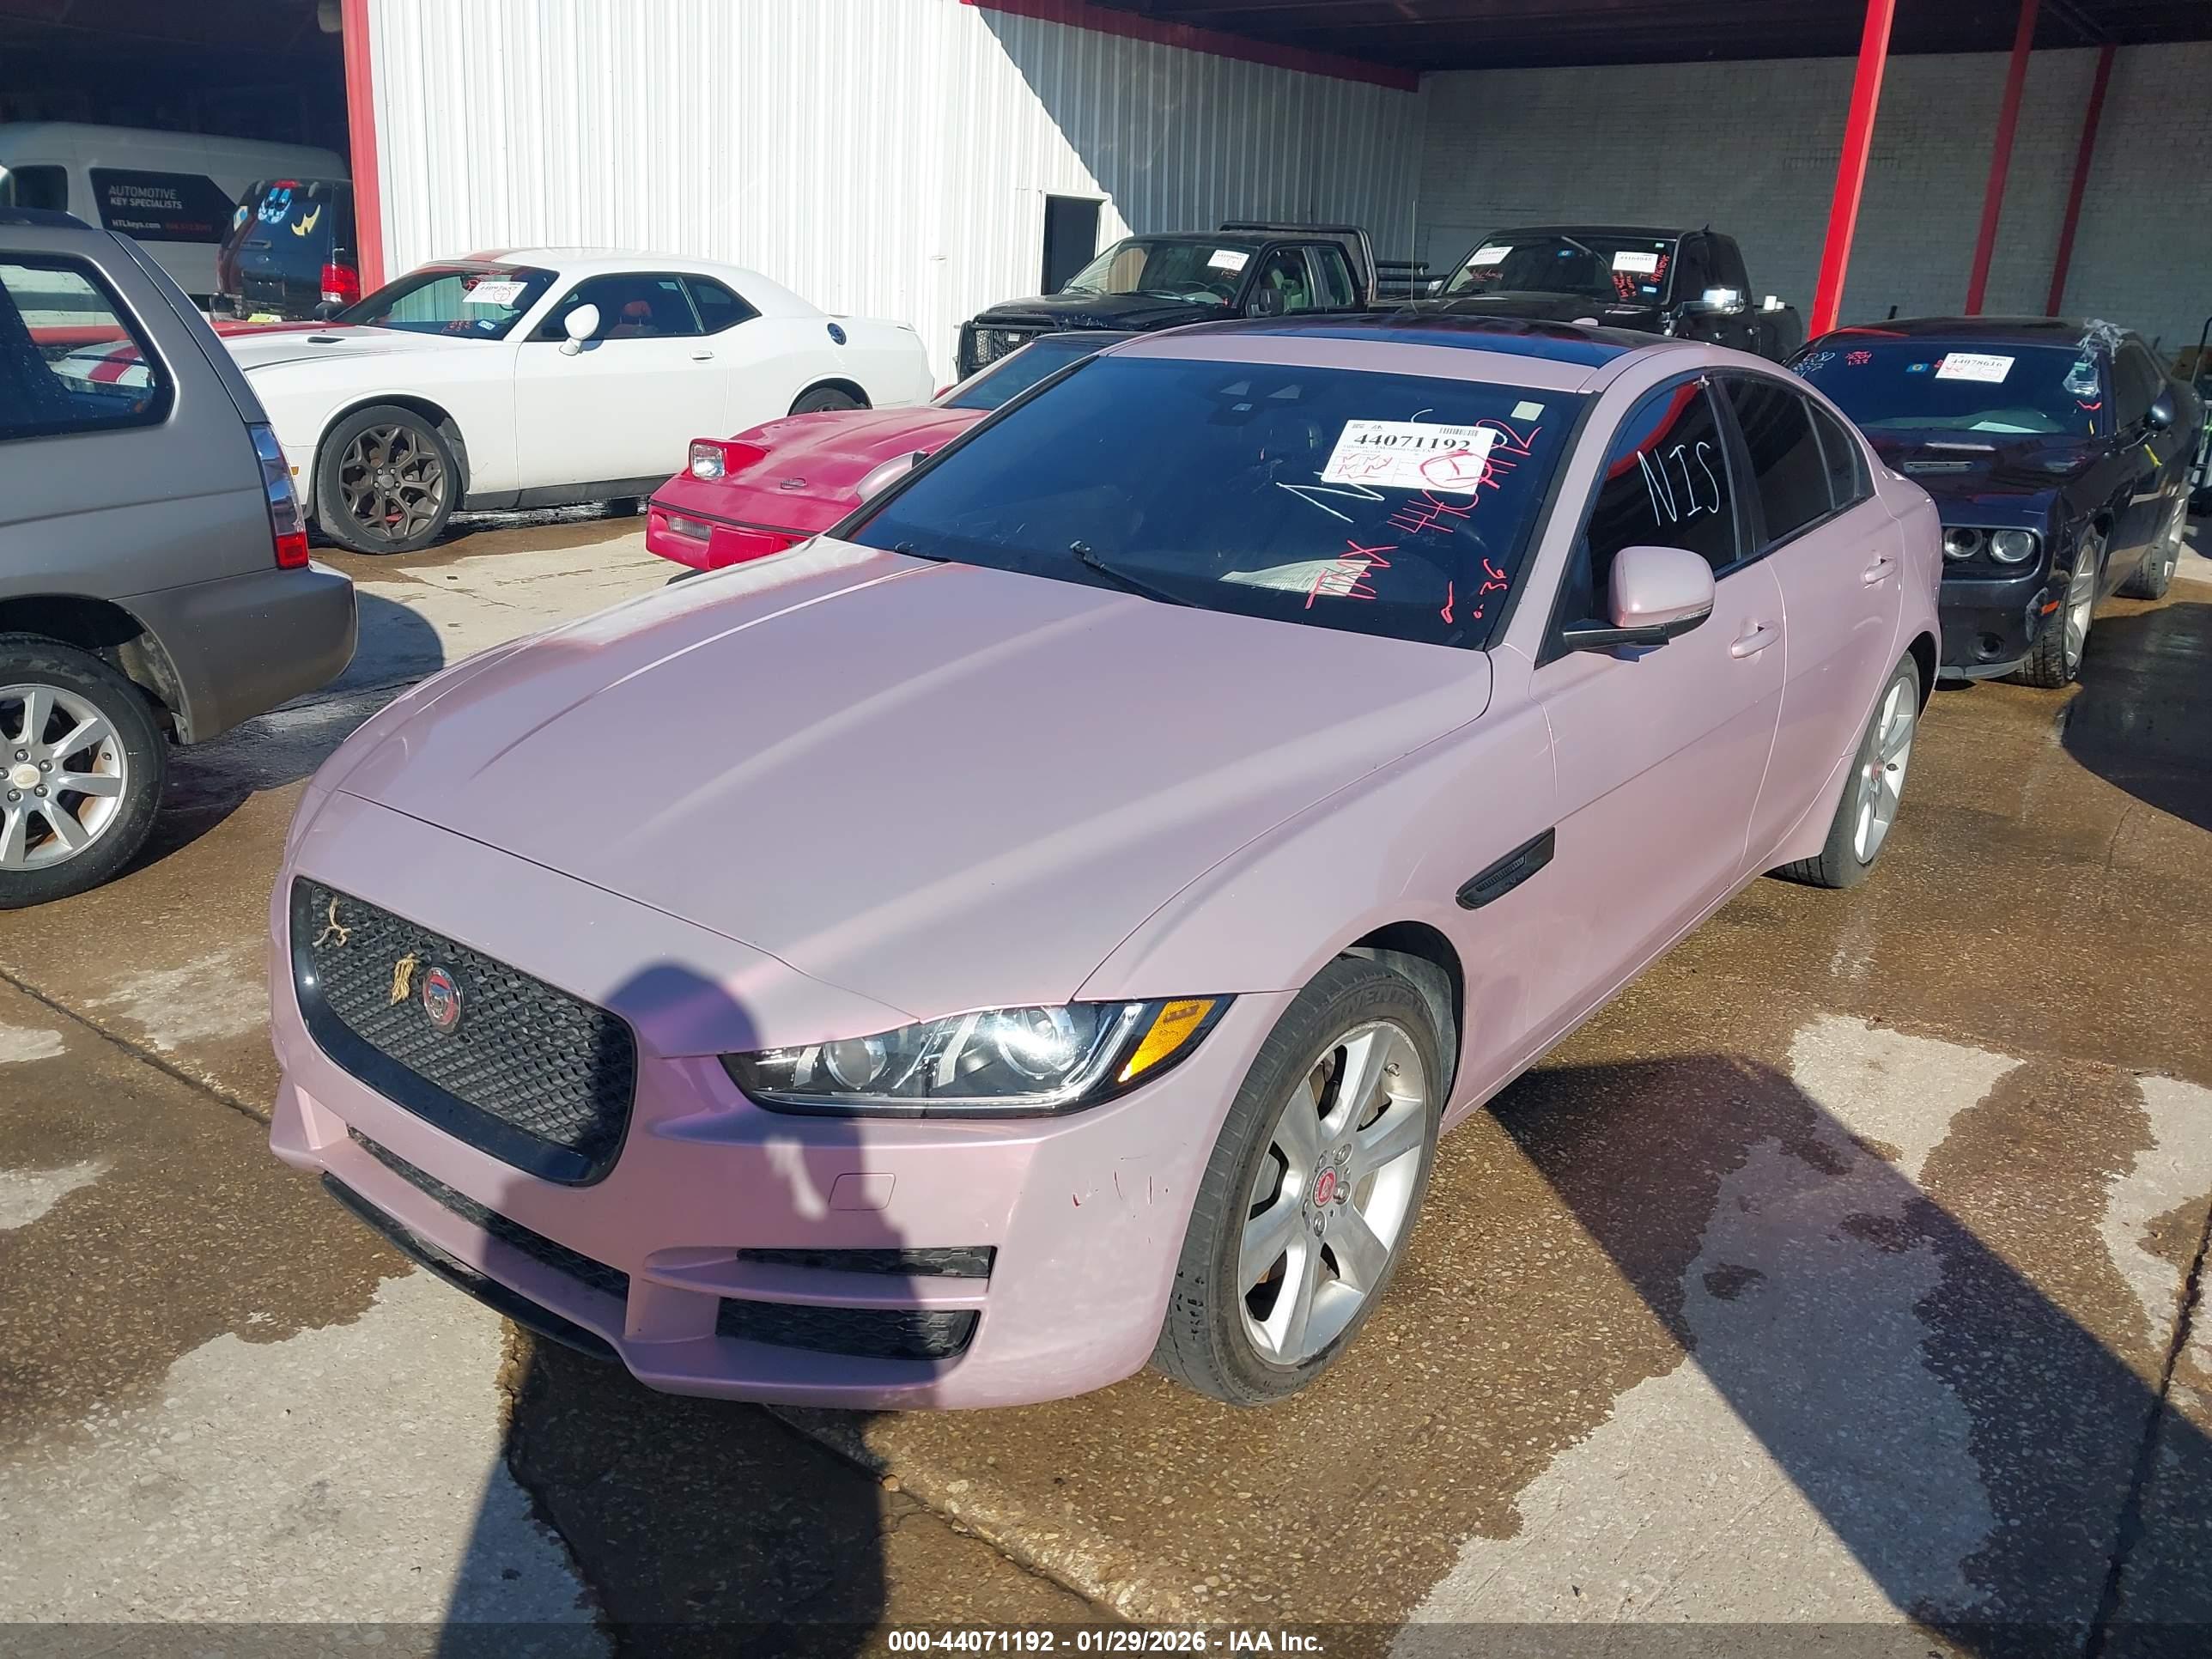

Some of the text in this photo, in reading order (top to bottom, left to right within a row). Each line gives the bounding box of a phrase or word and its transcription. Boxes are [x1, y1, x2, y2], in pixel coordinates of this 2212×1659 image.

[109, 185, 177, 199] AUTOMOTIVE
[110, 197, 183, 210] KEY SPECIALISTS
[1353, 433, 1471, 451] 44071192
[1637, 441, 1720, 527] NIS
